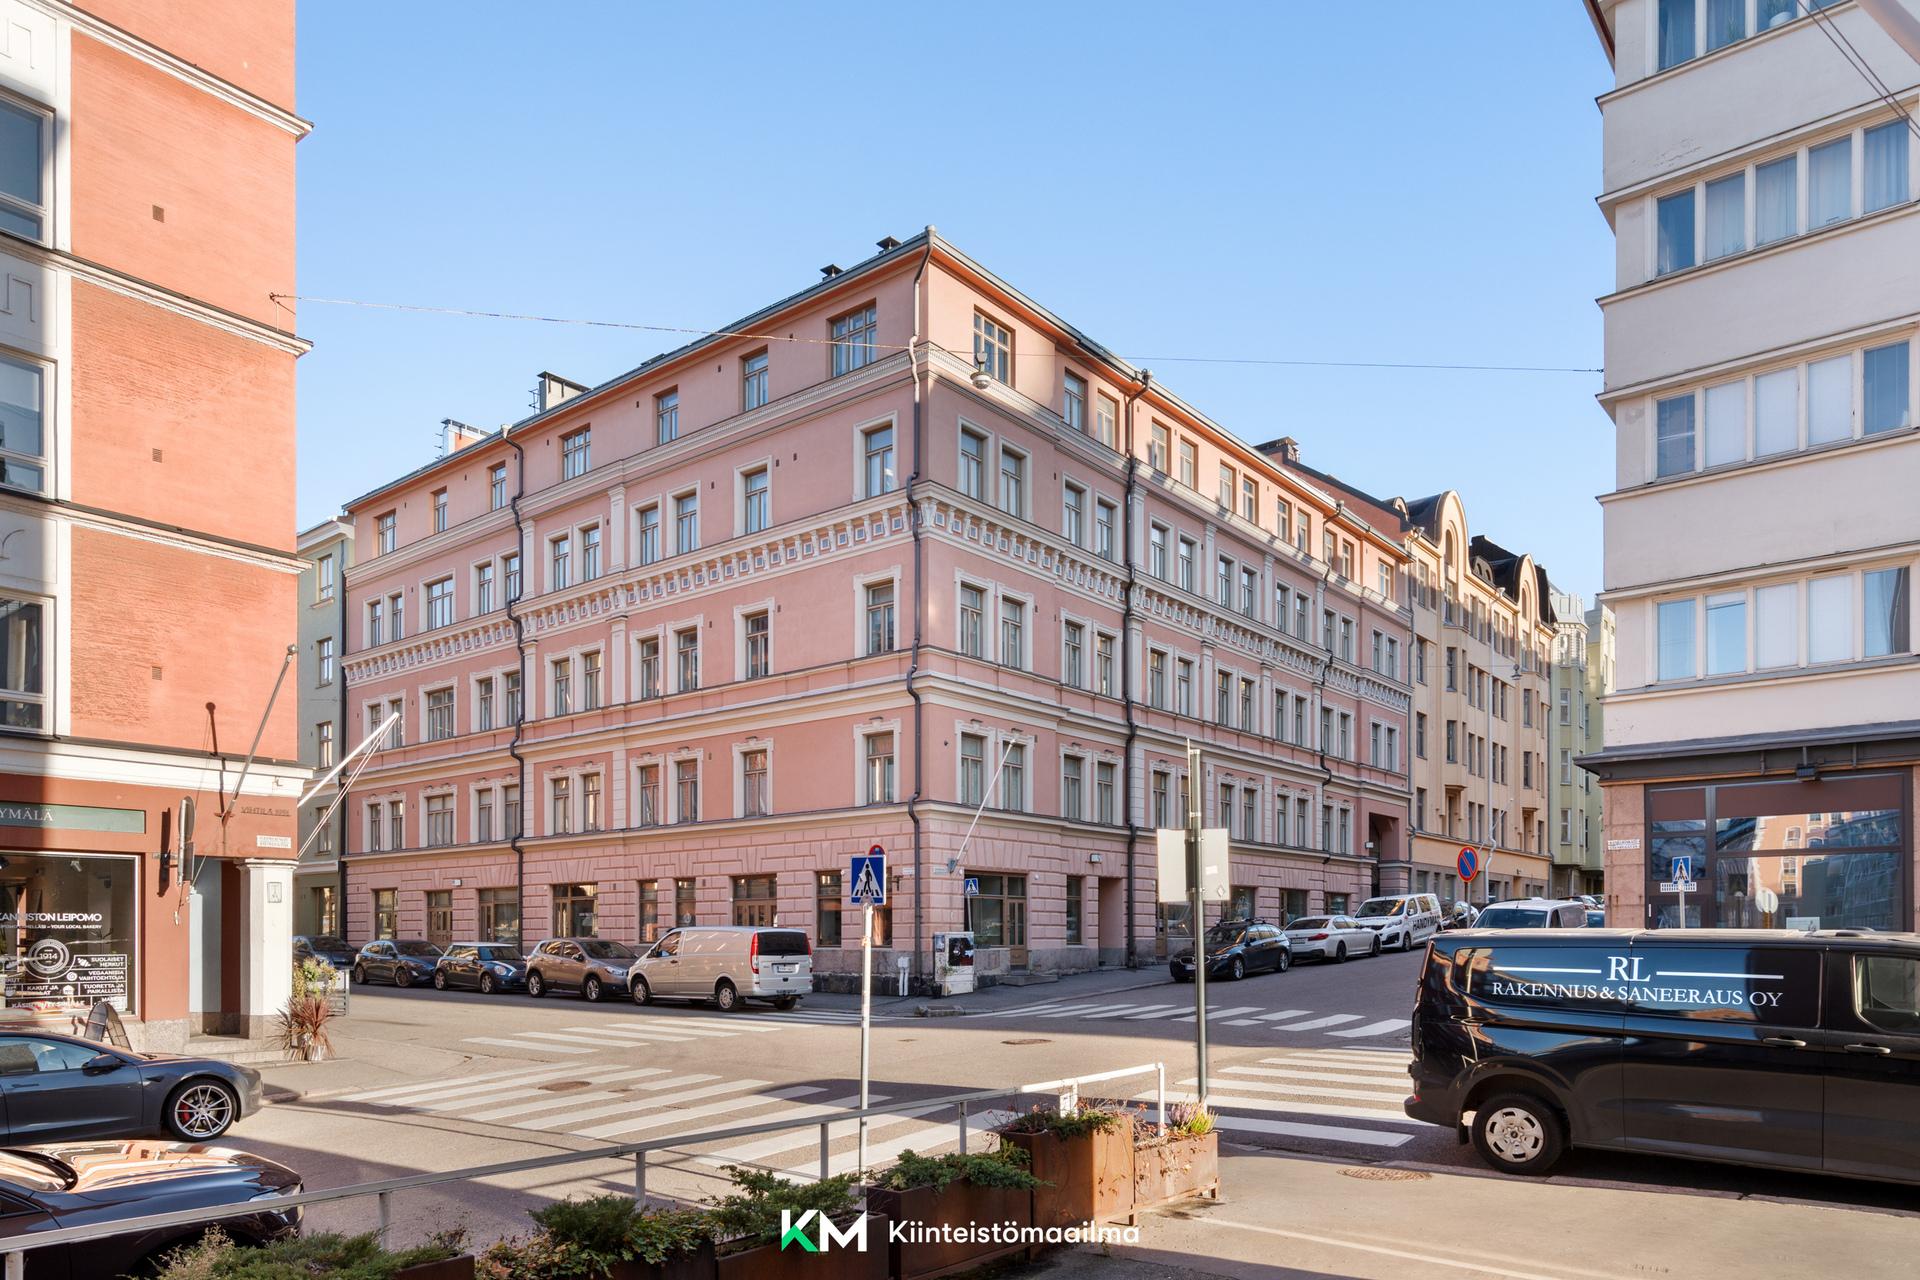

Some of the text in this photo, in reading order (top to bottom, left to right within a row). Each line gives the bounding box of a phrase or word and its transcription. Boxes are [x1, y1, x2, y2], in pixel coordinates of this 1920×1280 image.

[0, 807, 54, 822] YMÄLÄ
[57, 912, 102, 921] LEIPOMO
[1606, 956, 1651, 982] RL
[1492, 982, 1784, 1007] RAKENNUS & SANEERAUS OY
